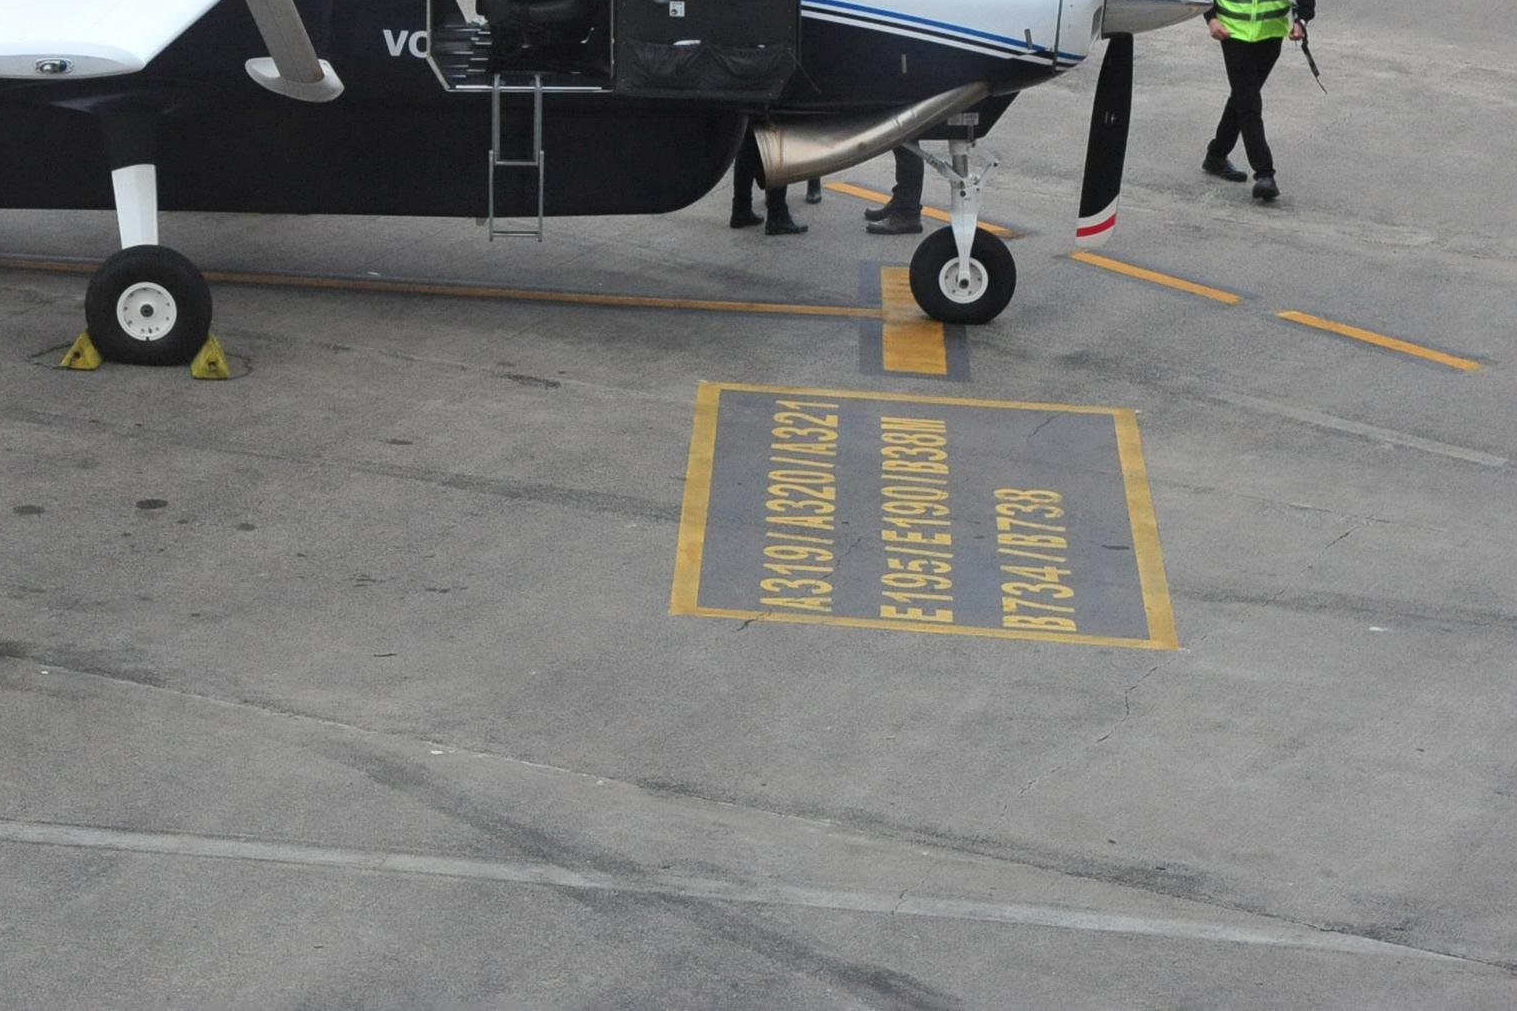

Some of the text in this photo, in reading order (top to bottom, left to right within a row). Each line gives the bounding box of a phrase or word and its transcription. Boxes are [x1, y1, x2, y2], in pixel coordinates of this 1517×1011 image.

[759, 399, 839, 612] A319/A320/A321
[880, 416, 955, 623] E195/E190/B38M
[994, 488, 1077, 632] B734/B738
